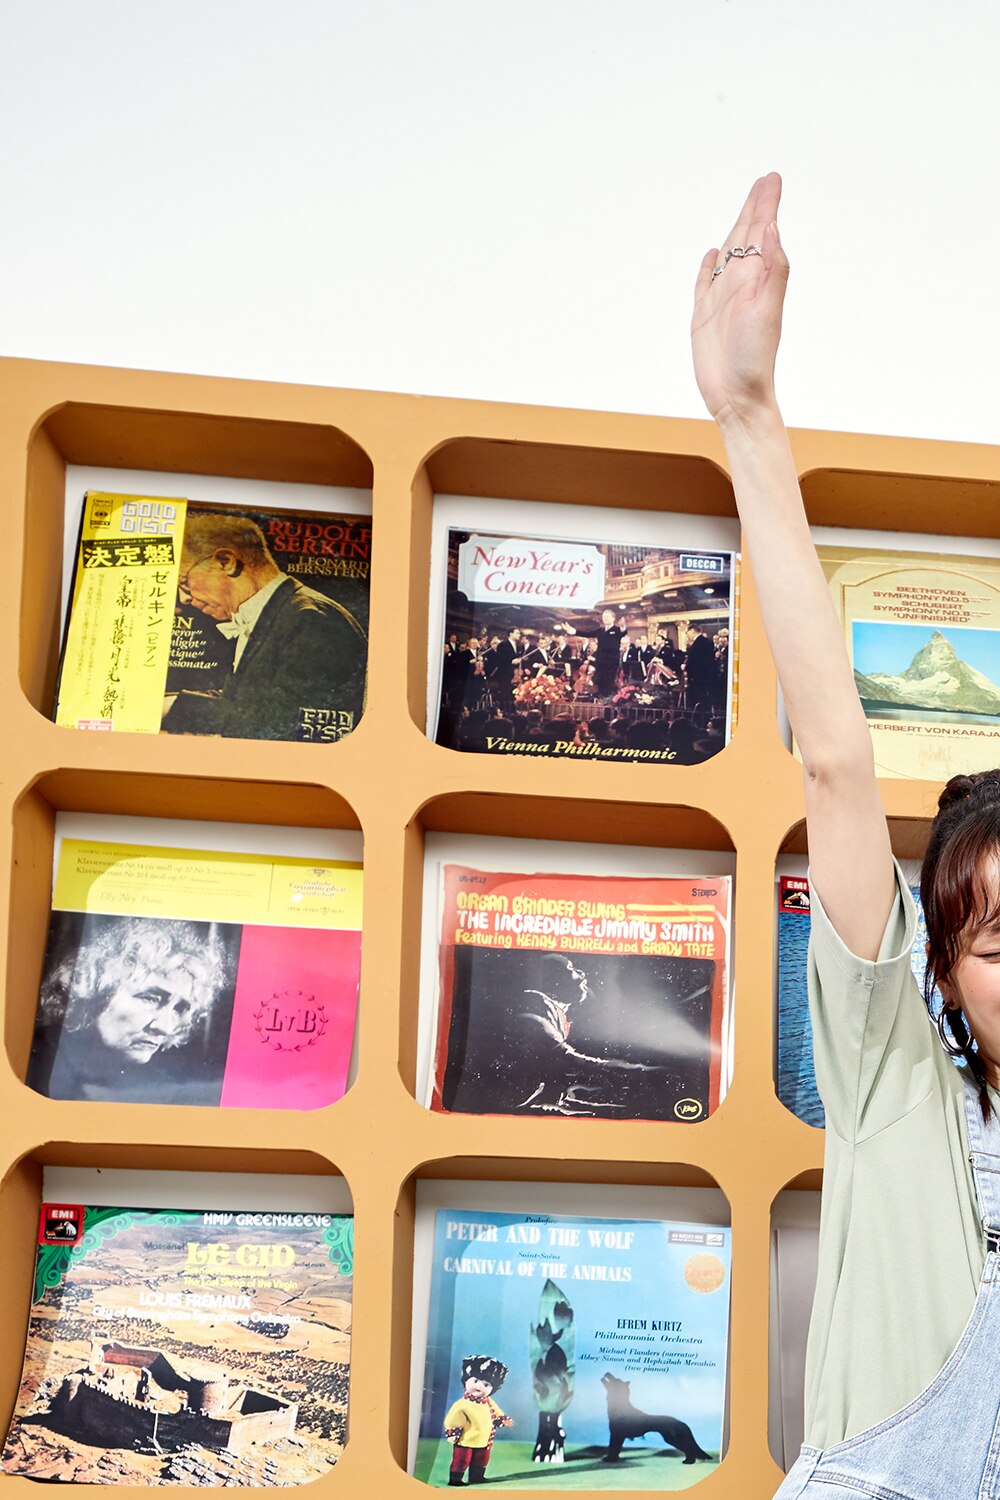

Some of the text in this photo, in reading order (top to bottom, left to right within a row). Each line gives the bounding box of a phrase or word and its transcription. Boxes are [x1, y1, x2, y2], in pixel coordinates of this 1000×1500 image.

[120, 516, 175, 535] DISC
[267, 519, 372, 543] RUDOLF
[274, 534, 369, 559] SERKIN
[83, 544, 175, 568] 決定盤
[299, 556, 369, 570] LEONARD
[471, 546, 594, 575] New Year's
[287, 563, 368, 579] BERNSTEIN
[686, 558, 717, 570] DECCA
[484, 571, 581, 597] Concert
[896, 586, 966, 596] BEETHOVEN
[873, 591, 939, 601] SYMPHONY
[873, 604, 940, 614] SYMPHONY
[901, 600, 964, 610] SCHUBERT
[868, 723, 922, 733] HERBERT
[924, 727, 951, 735] VON
[485, 736, 550, 753] Vienna
[552, 740, 677, 760] Philharmonic
[786, 880, 808, 890] EMI
[456, 891, 626, 921] ORGAN GRINDER SWING
[456, 910, 715, 942] THE INCREDIBLE JIMMY SMITH
[455, 928, 513, 949] Featuring
[560, 936, 616, 953] BURRELL
[617, 942, 638, 953] and
[641, 941, 683, 956] GRADY
[685, 942, 716, 957] TATE
[51, 1209, 74, 1219] EMI
[203, 1213, 332, 1227] HMV GREENSLEEVE
[446, 1221, 636, 1251] PETER AND THE WOLF
[186, 1242, 232, 1266] LE
[235, 1243, 296, 1267] CID
[443, 1256, 633, 1283] CARNIVAL OF THE ANIMALS
[272, 1279, 298, 1291] Virgin
[617, 1318, 683, 1332] EFREM KURTZ
[594, 1330, 704, 1345] Philharmonia Orchestra
[599, 1346, 627, 1355] Michael
[629, 1348, 661, 1357] Flanders
[602, 1355, 625, 1363] Simon
[626, 1356, 641, 1364] and
